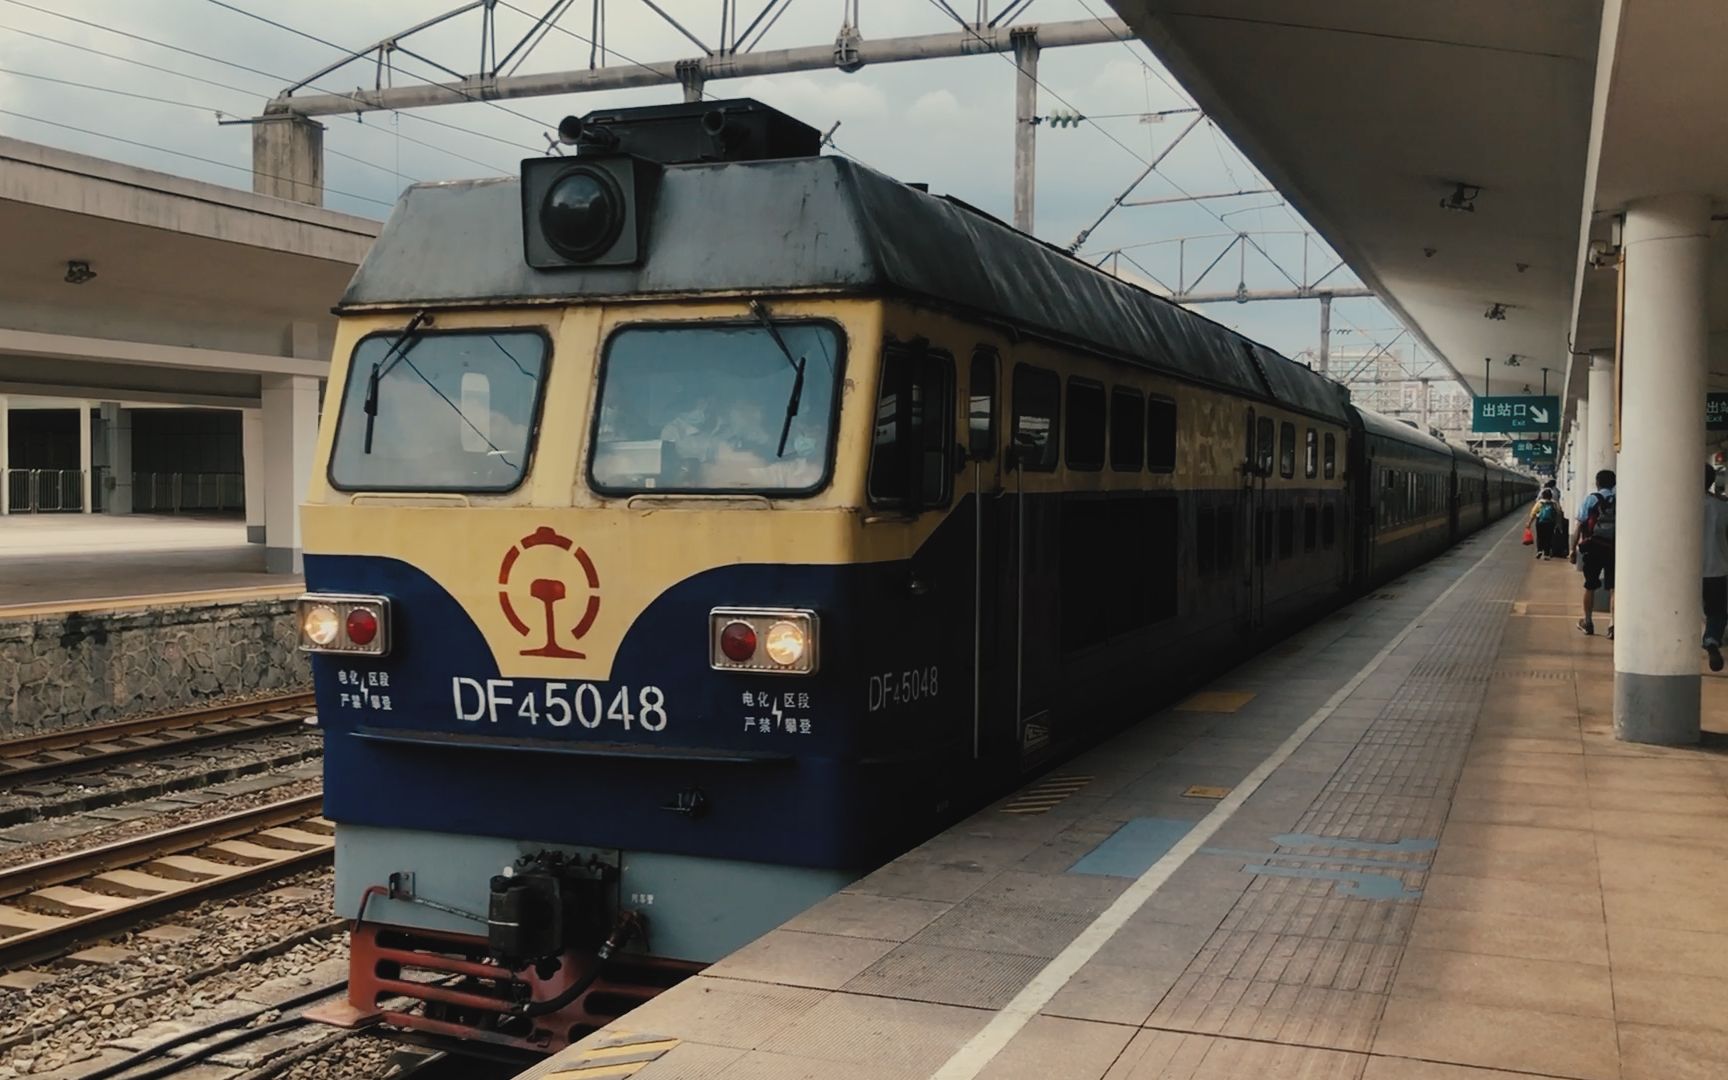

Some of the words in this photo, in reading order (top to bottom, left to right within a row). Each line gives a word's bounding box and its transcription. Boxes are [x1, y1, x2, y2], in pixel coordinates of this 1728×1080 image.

[1482, 403, 1526, 417] 出站口
[1512, 419, 1526, 427] Exit
[868, 665, 938, 712] DF45048
[452, 676, 668, 732] DF45048
